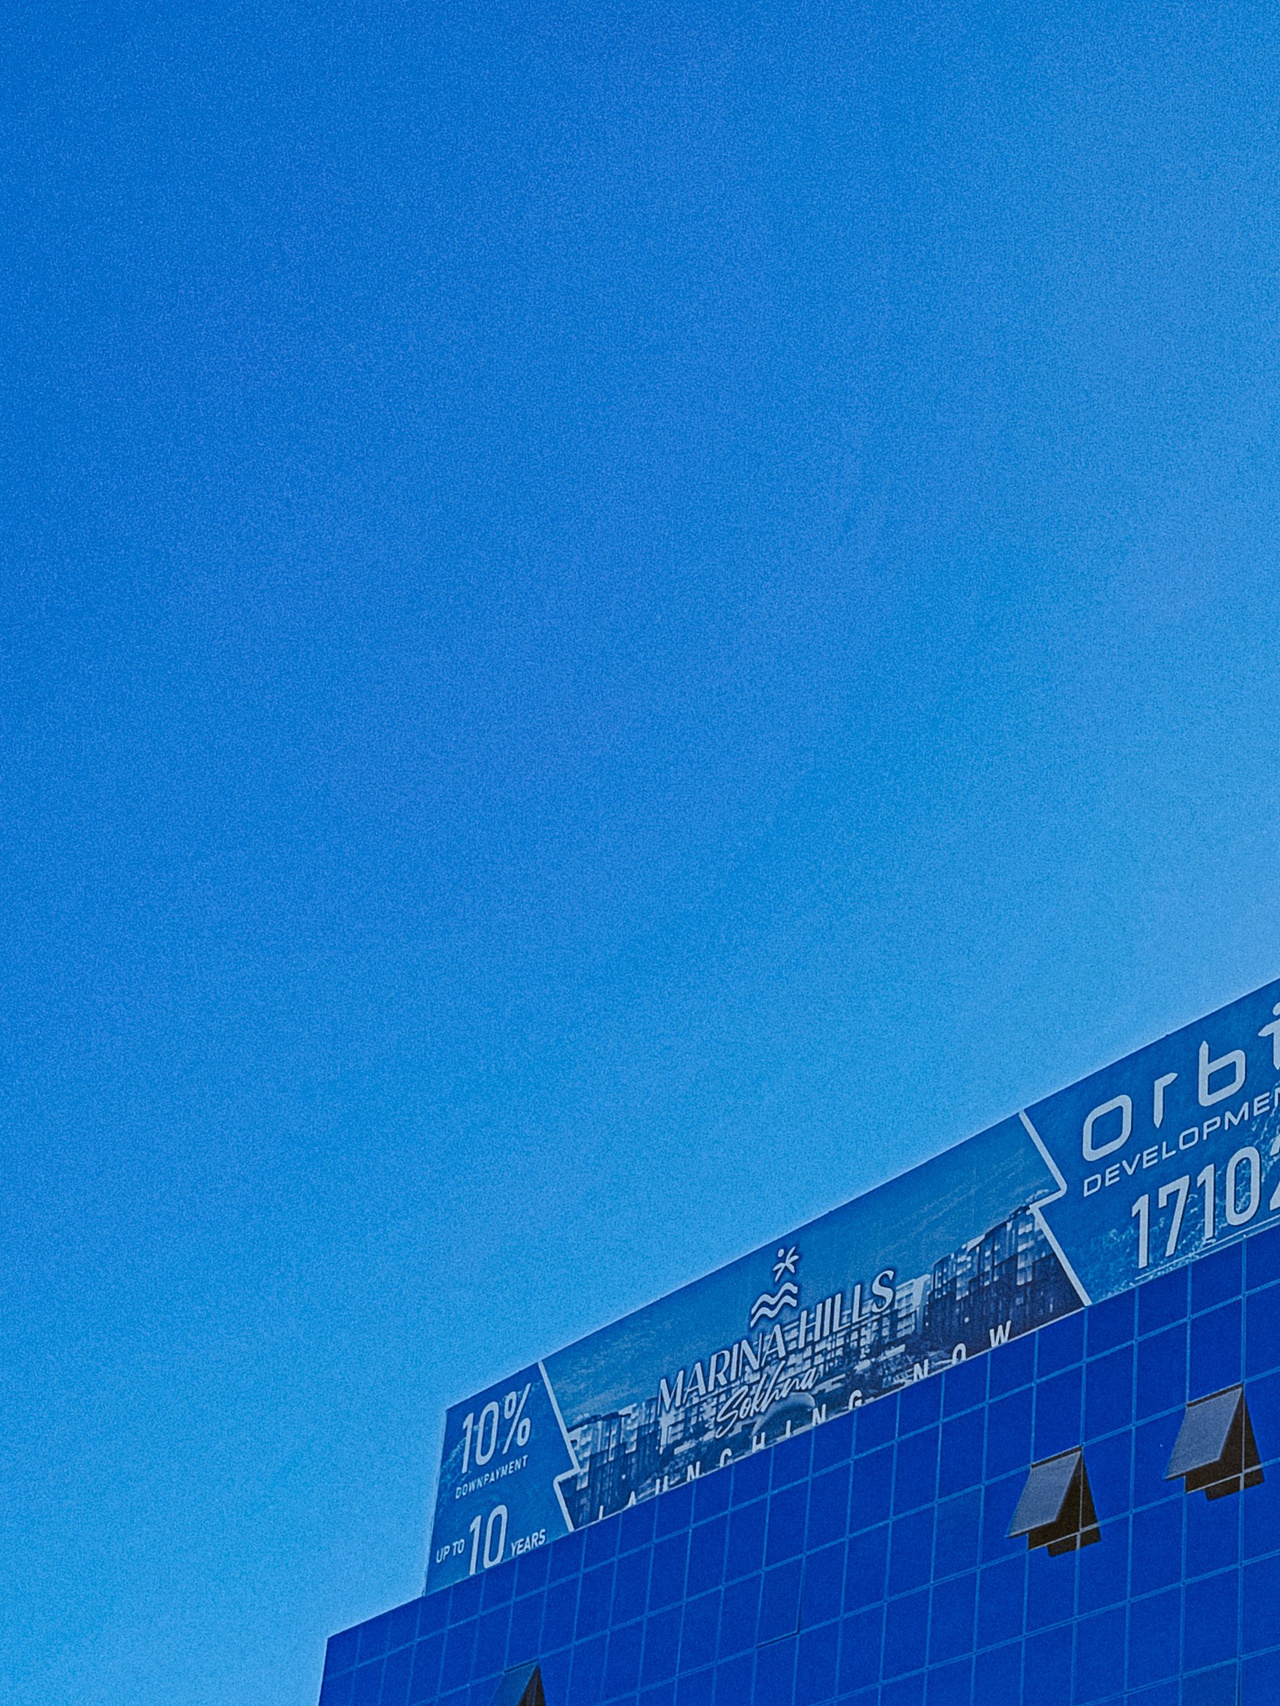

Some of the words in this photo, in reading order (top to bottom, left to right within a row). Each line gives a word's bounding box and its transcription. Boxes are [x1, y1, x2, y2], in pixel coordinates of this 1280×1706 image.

[657, 1331, 786, 1416] MARINA
[798, 1269, 896, 1349] HILLS
[462, 1382, 532, 1475] 10%
[716, 1360, 820, 1440] Sokhna
[455, 1454, 529, 1500] DOWNPAYMENT
[436, 1545, 451, 1564] UP
[452, 1538, 465, 1556] TO
[469, 1504, 508, 1576] 10
[511, 1529, 546, 1557] YEARS
